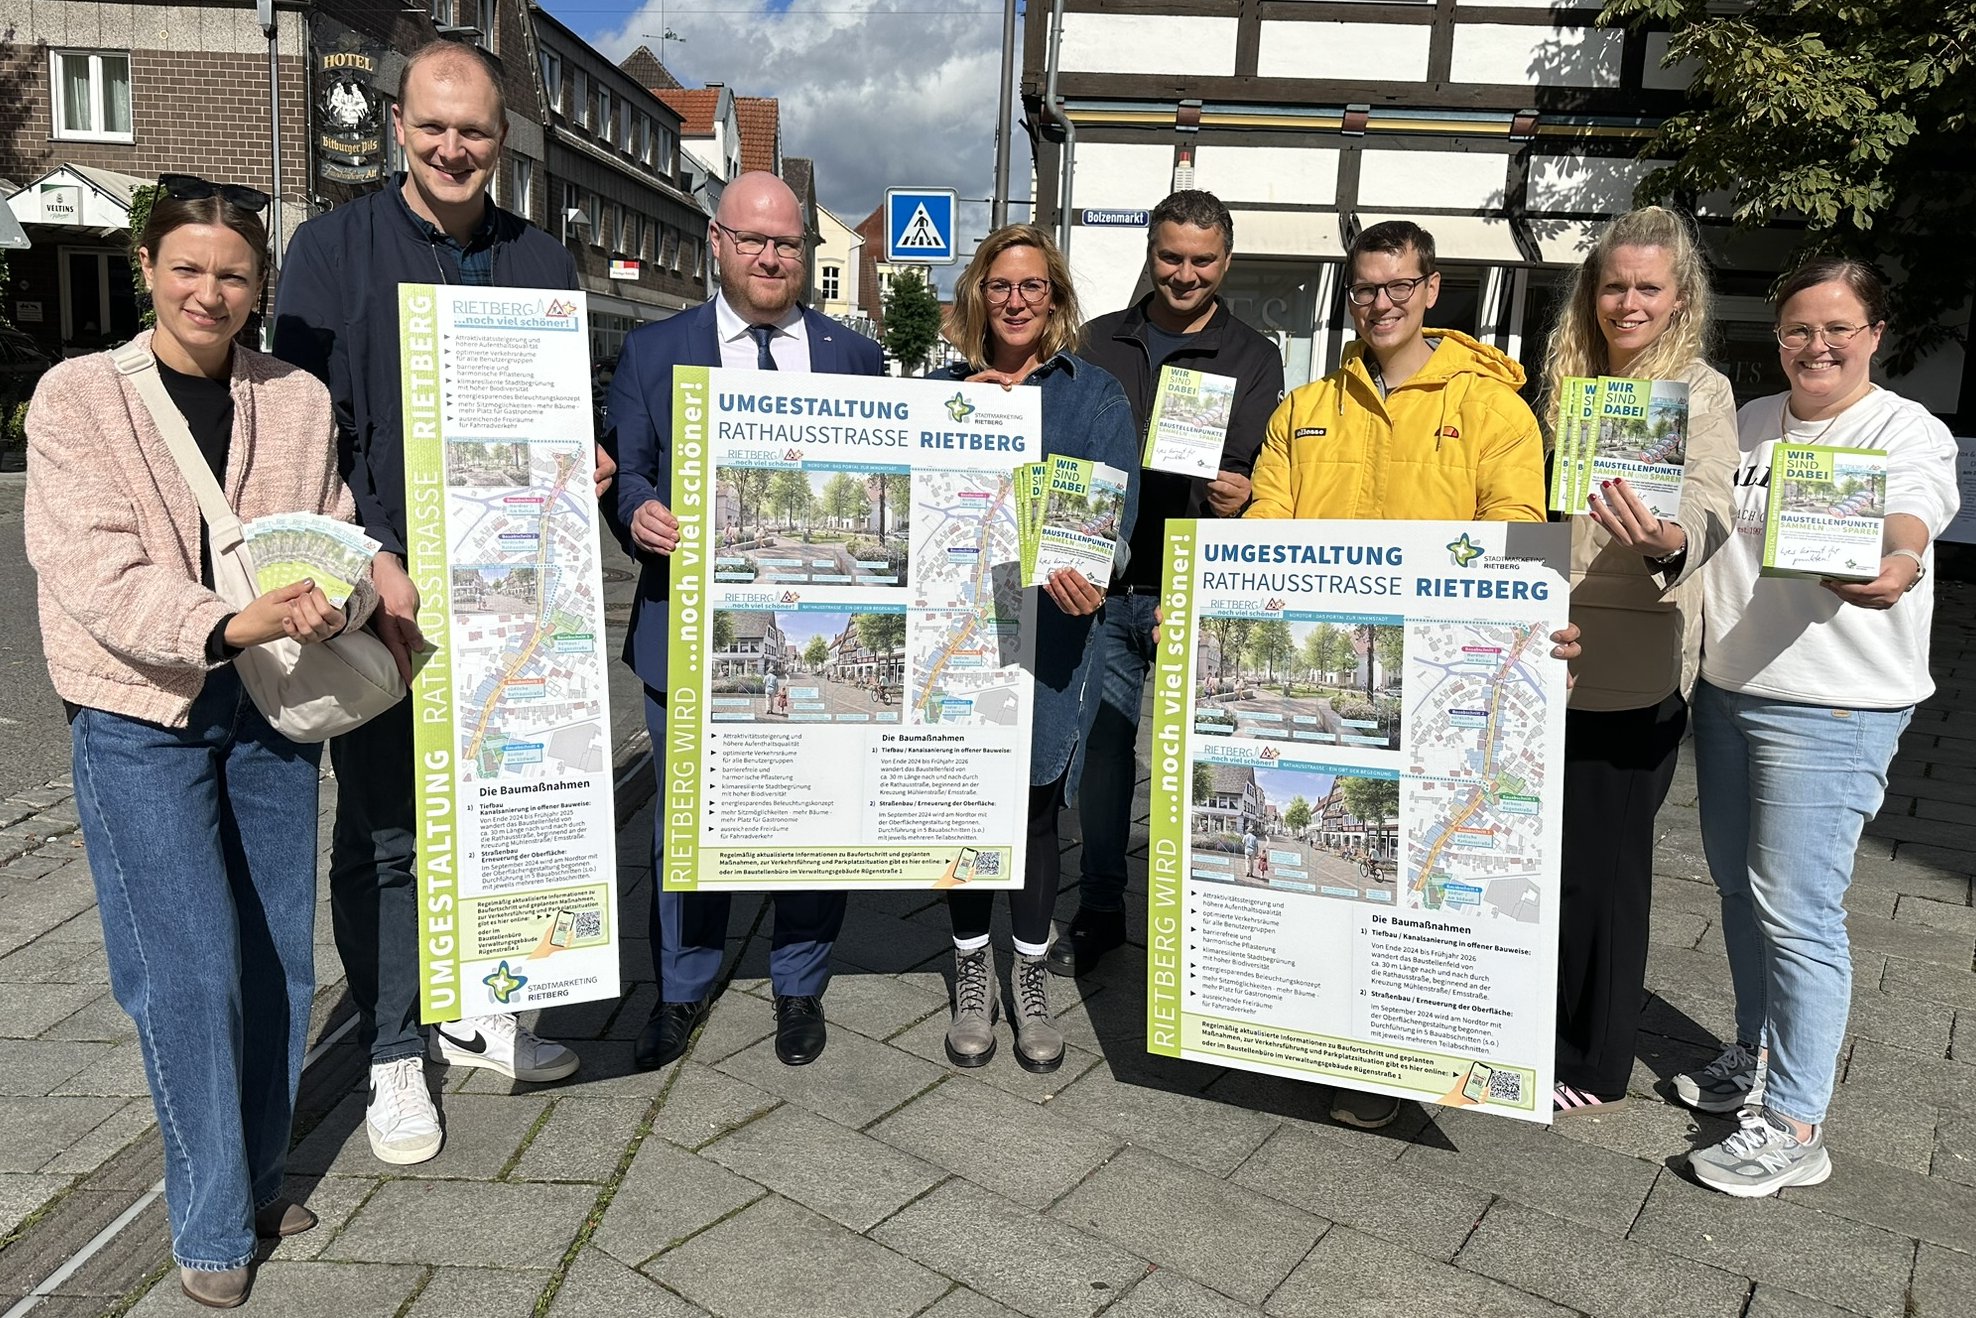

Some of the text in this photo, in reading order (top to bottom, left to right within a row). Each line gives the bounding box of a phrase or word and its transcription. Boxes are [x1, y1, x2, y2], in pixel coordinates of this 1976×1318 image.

[324, 53, 373, 72] HOTEL
[322, 136, 378, 155] Bitburger Pils
[46, 204, 74, 212] VELTINS
[1088, 211, 1144, 224] Bolzenmarkt
[453, 300, 533, 316] RIETBERG
[454, 316, 569, 327] ...noch viel schöner!
[407, 294, 436, 439] RIETBERG
[1171, 368, 1189, 378] WIR
[1170, 376, 1191, 386] SIND
[1608, 381, 1634, 393] WIR
[1168, 384, 1196, 395] DABEI
[719, 394, 909, 420] UMGESTALTUNG
[1606, 393, 1636, 405] SIND
[1604, 405, 1644, 417] DABEI
[719, 422, 908, 446] RATHAUSSTRASSE
[1160, 422, 1223, 437] BAUSTELLENPUNKTE
[920, 431, 1025, 452] RIETBERG
[728, 449, 777, 459] RIETBERG
[1788, 451, 1815, 460] WIR
[1056, 459, 1078, 471] WIR
[1594, 460, 1682, 476] BAUSTELLENPUNKTE
[1787, 460, 1818, 469] SIND
[1054, 469, 1079, 481] SIND
[1593, 468, 1633, 478] SAMMELN
[1650, 473, 1681, 483] SPAREN
[1786, 470, 1828, 480] DABEI
[1052, 479, 1086, 494] DABEI
[1781, 515, 1879, 529] BAUSTELLENPUNKTE
[1042, 528, 1114, 550] BAUSTELLENPUNKTE
[1843, 527, 1878, 535] SPAREN
[1042, 535, 1074, 546] SAMMELN
[1088, 544, 1112, 556] SPAREN
[1204, 544, 1402, 565] UMGESTALTUNG
[1203, 572, 1402, 595] RATHAUSSTRASSE
[1416, 578, 1548, 600] RIETBERG
[725, 593, 773, 602] RIETBERG
[1210, 600, 1258, 609] RIETBERG
[670, 382, 703, 884] RIETBERG WIRD ...noch viel schöner!
[1204, 746, 1252, 757] RIETBERG
[1243, 758, 1274, 767] schöner!
[479, 780, 590, 797] Die Baumaßnahmen
[1154, 534, 1191, 1048] RIETBERG WIRD ...noch viel schöner!
[424, 750, 456, 1010] UMGESTALTUNG
[1372, 915, 1471, 934] Die Baumaßnahmen
[1372, 930, 1397, 938] Tiefbau
[1402, 934, 1457, 947] Kanalsanierung
[1466, 941, 1492, 950] offener
[1494, 945, 1532, 955] Bauweise:
[1371, 952, 1398, 960] wandert
[1412, 957, 1460, 968] Baustellenfeld
[1430, 950, 1458, 960] Frühjahr
[528, 976, 598, 992] STADTMARKETING
[1382, 971, 1431, 984] Rathausstraße,
[1431, 977, 1468, 989] beginnend
[528, 989, 569, 1001] RIETBERG
[1371, 978, 1490, 999] Kreuzung Mühlenstraße/ Emsstraße.
[1371, 991, 1410, 1002] Straßenbau
[1415, 997, 1456, 1010] Erneuerung
[1471, 1005, 1514, 1016] Oberfläche:
[1202, 1021, 1238, 1034] Regelmäßig
[1239, 1027, 1279, 1039] aktualisierte
[1280, 1034, 1327, 1047] Informationen
[1336, 1043, 1383, 1056] Baufortschritt
[1399, 1054, 1434, 1066] geplanten
[1202, 1030, 1242, 1043] Maßnahmen,
[1254, 1038, 1308, 1054] Verkehrsführung
[1322, 1050, 1384, 1066] Parkplatzsituation
[1385, 1060, 1399, 1068] gibt
[1424, 1066, 1449, 1075] online:
[1226, 1044, 1274, 1057] Baustellenbüro
[1283, 1054, 1352, 1072] Verwaltungsgebäude
[1353, 1066, 1396, 1080] Rügenstraße
